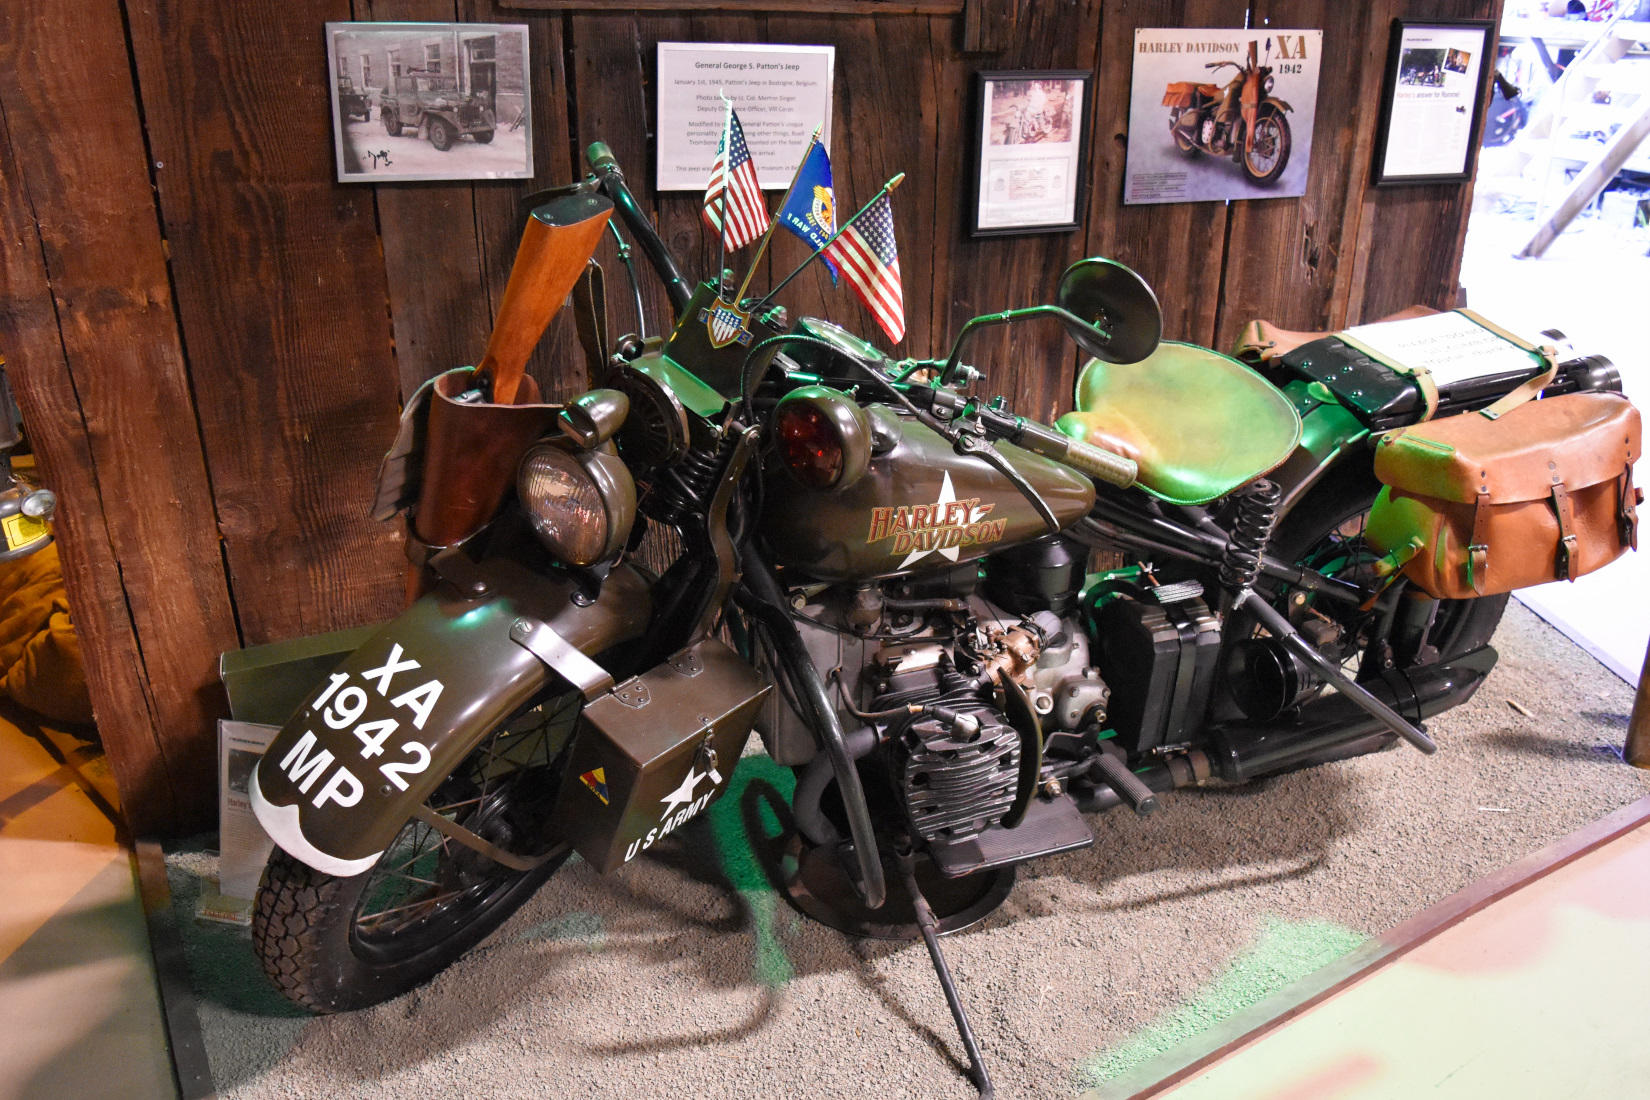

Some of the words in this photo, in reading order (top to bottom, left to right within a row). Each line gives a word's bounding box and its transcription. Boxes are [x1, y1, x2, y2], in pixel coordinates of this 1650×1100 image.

[723, 62, 748, 70] George
[1138, 42, 1182, 54] HARLEY
[1186, 42, 1240, 53] DAVIDSON
[1274, 35, 1307, 60] XA
[1278, 64, 1302, 74] 1942
[890, 518, 1008, 556] DAVIDSON
[360, 642, 444, 731] XA
[312, 672, 432, 792] 1942
[279, 730, 364, 809] MP
[658, 788, 716, 840] ARMY
